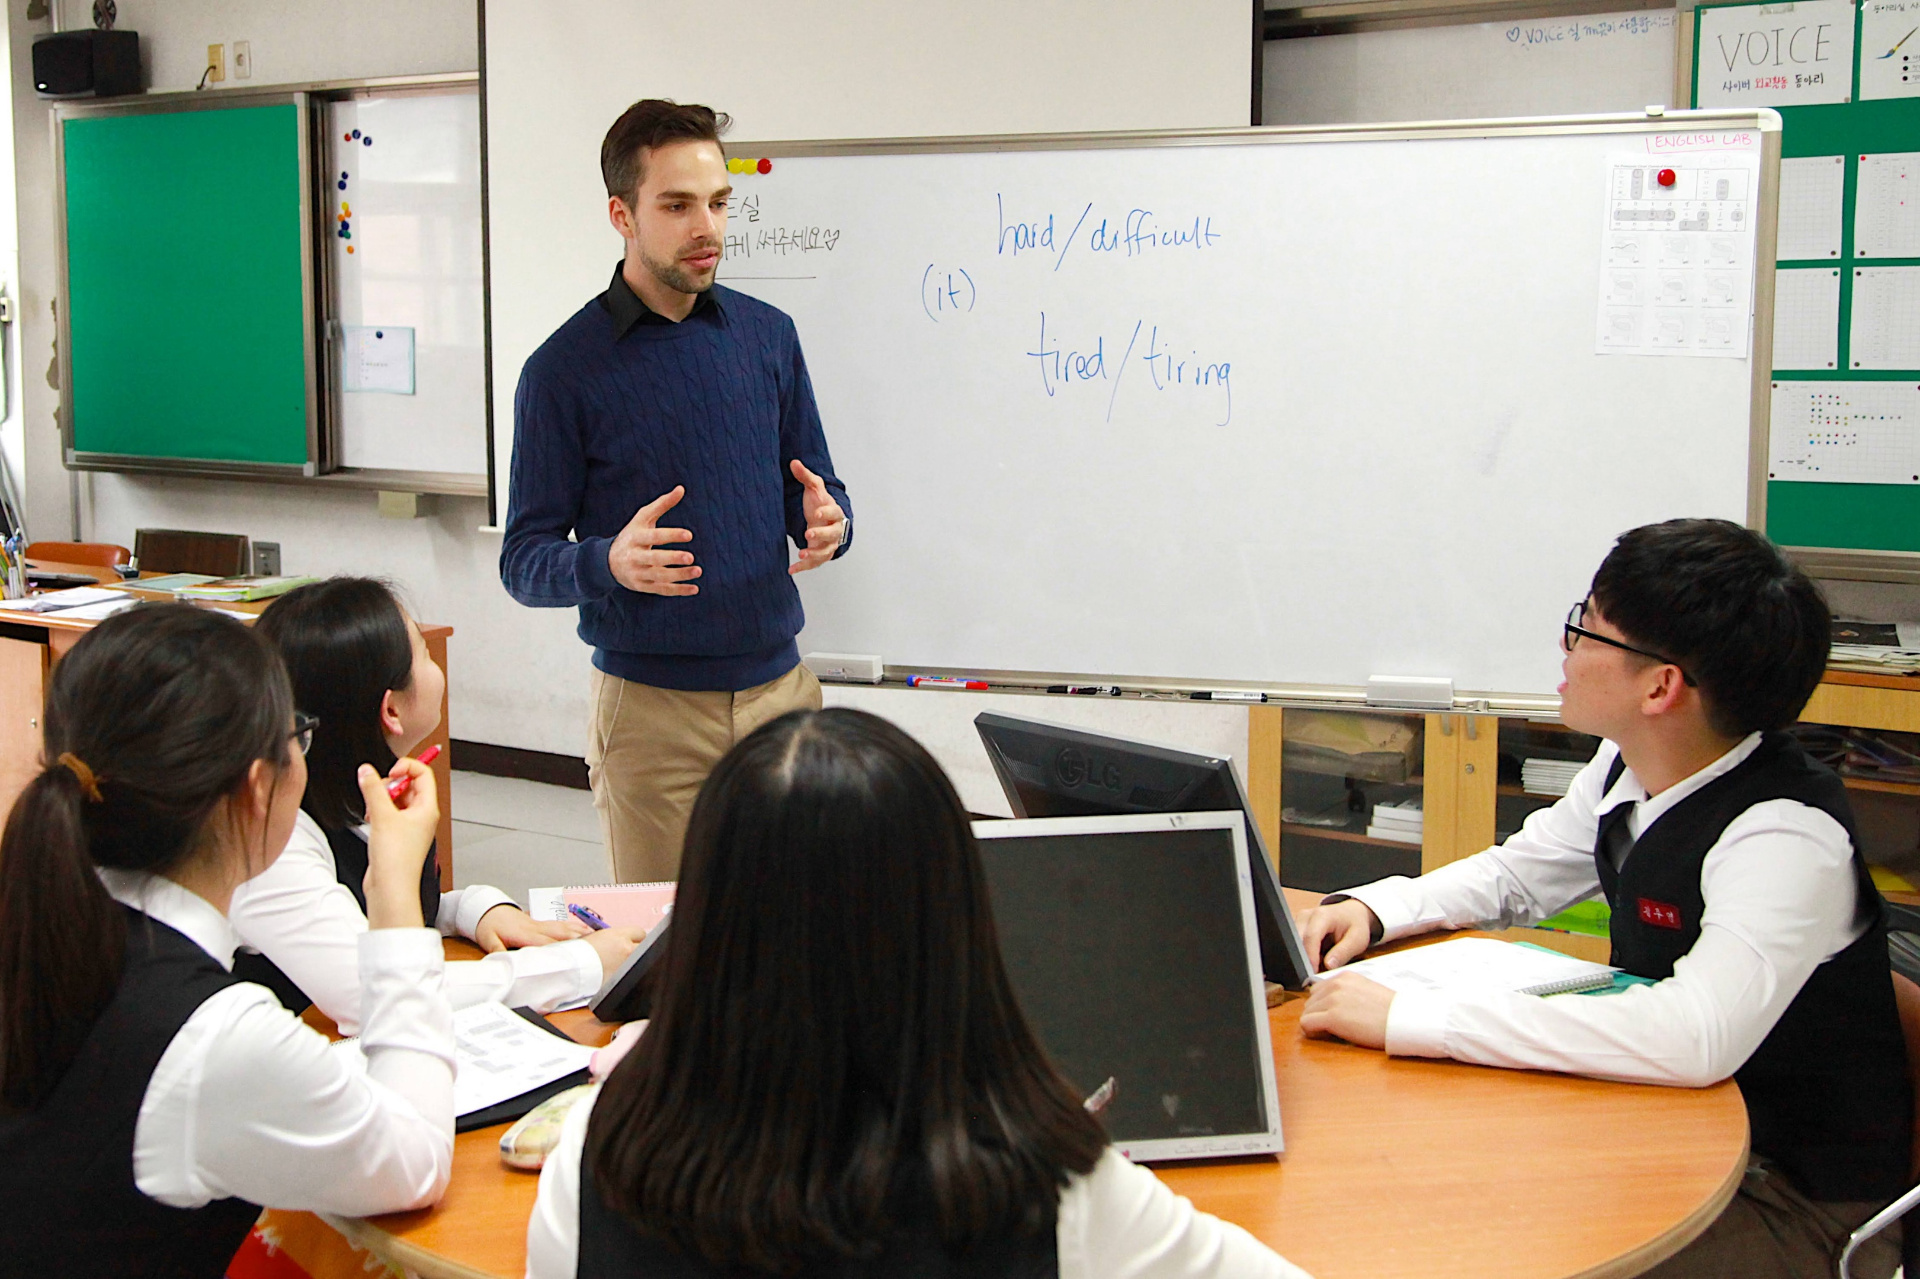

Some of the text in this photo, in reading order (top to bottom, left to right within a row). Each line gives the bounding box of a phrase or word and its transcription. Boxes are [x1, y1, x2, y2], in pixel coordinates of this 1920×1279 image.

[1717, 24, 1831, 72] VOICE
[1722, 79, 1751, 93] 사이버
[1795, 72, 1824, 88] 동아리
[1655, 133, 1752, 148] ENGLISH LAB
[922, 263, 975, 322] (it)
[1086, 756, 1122, 792] LG
